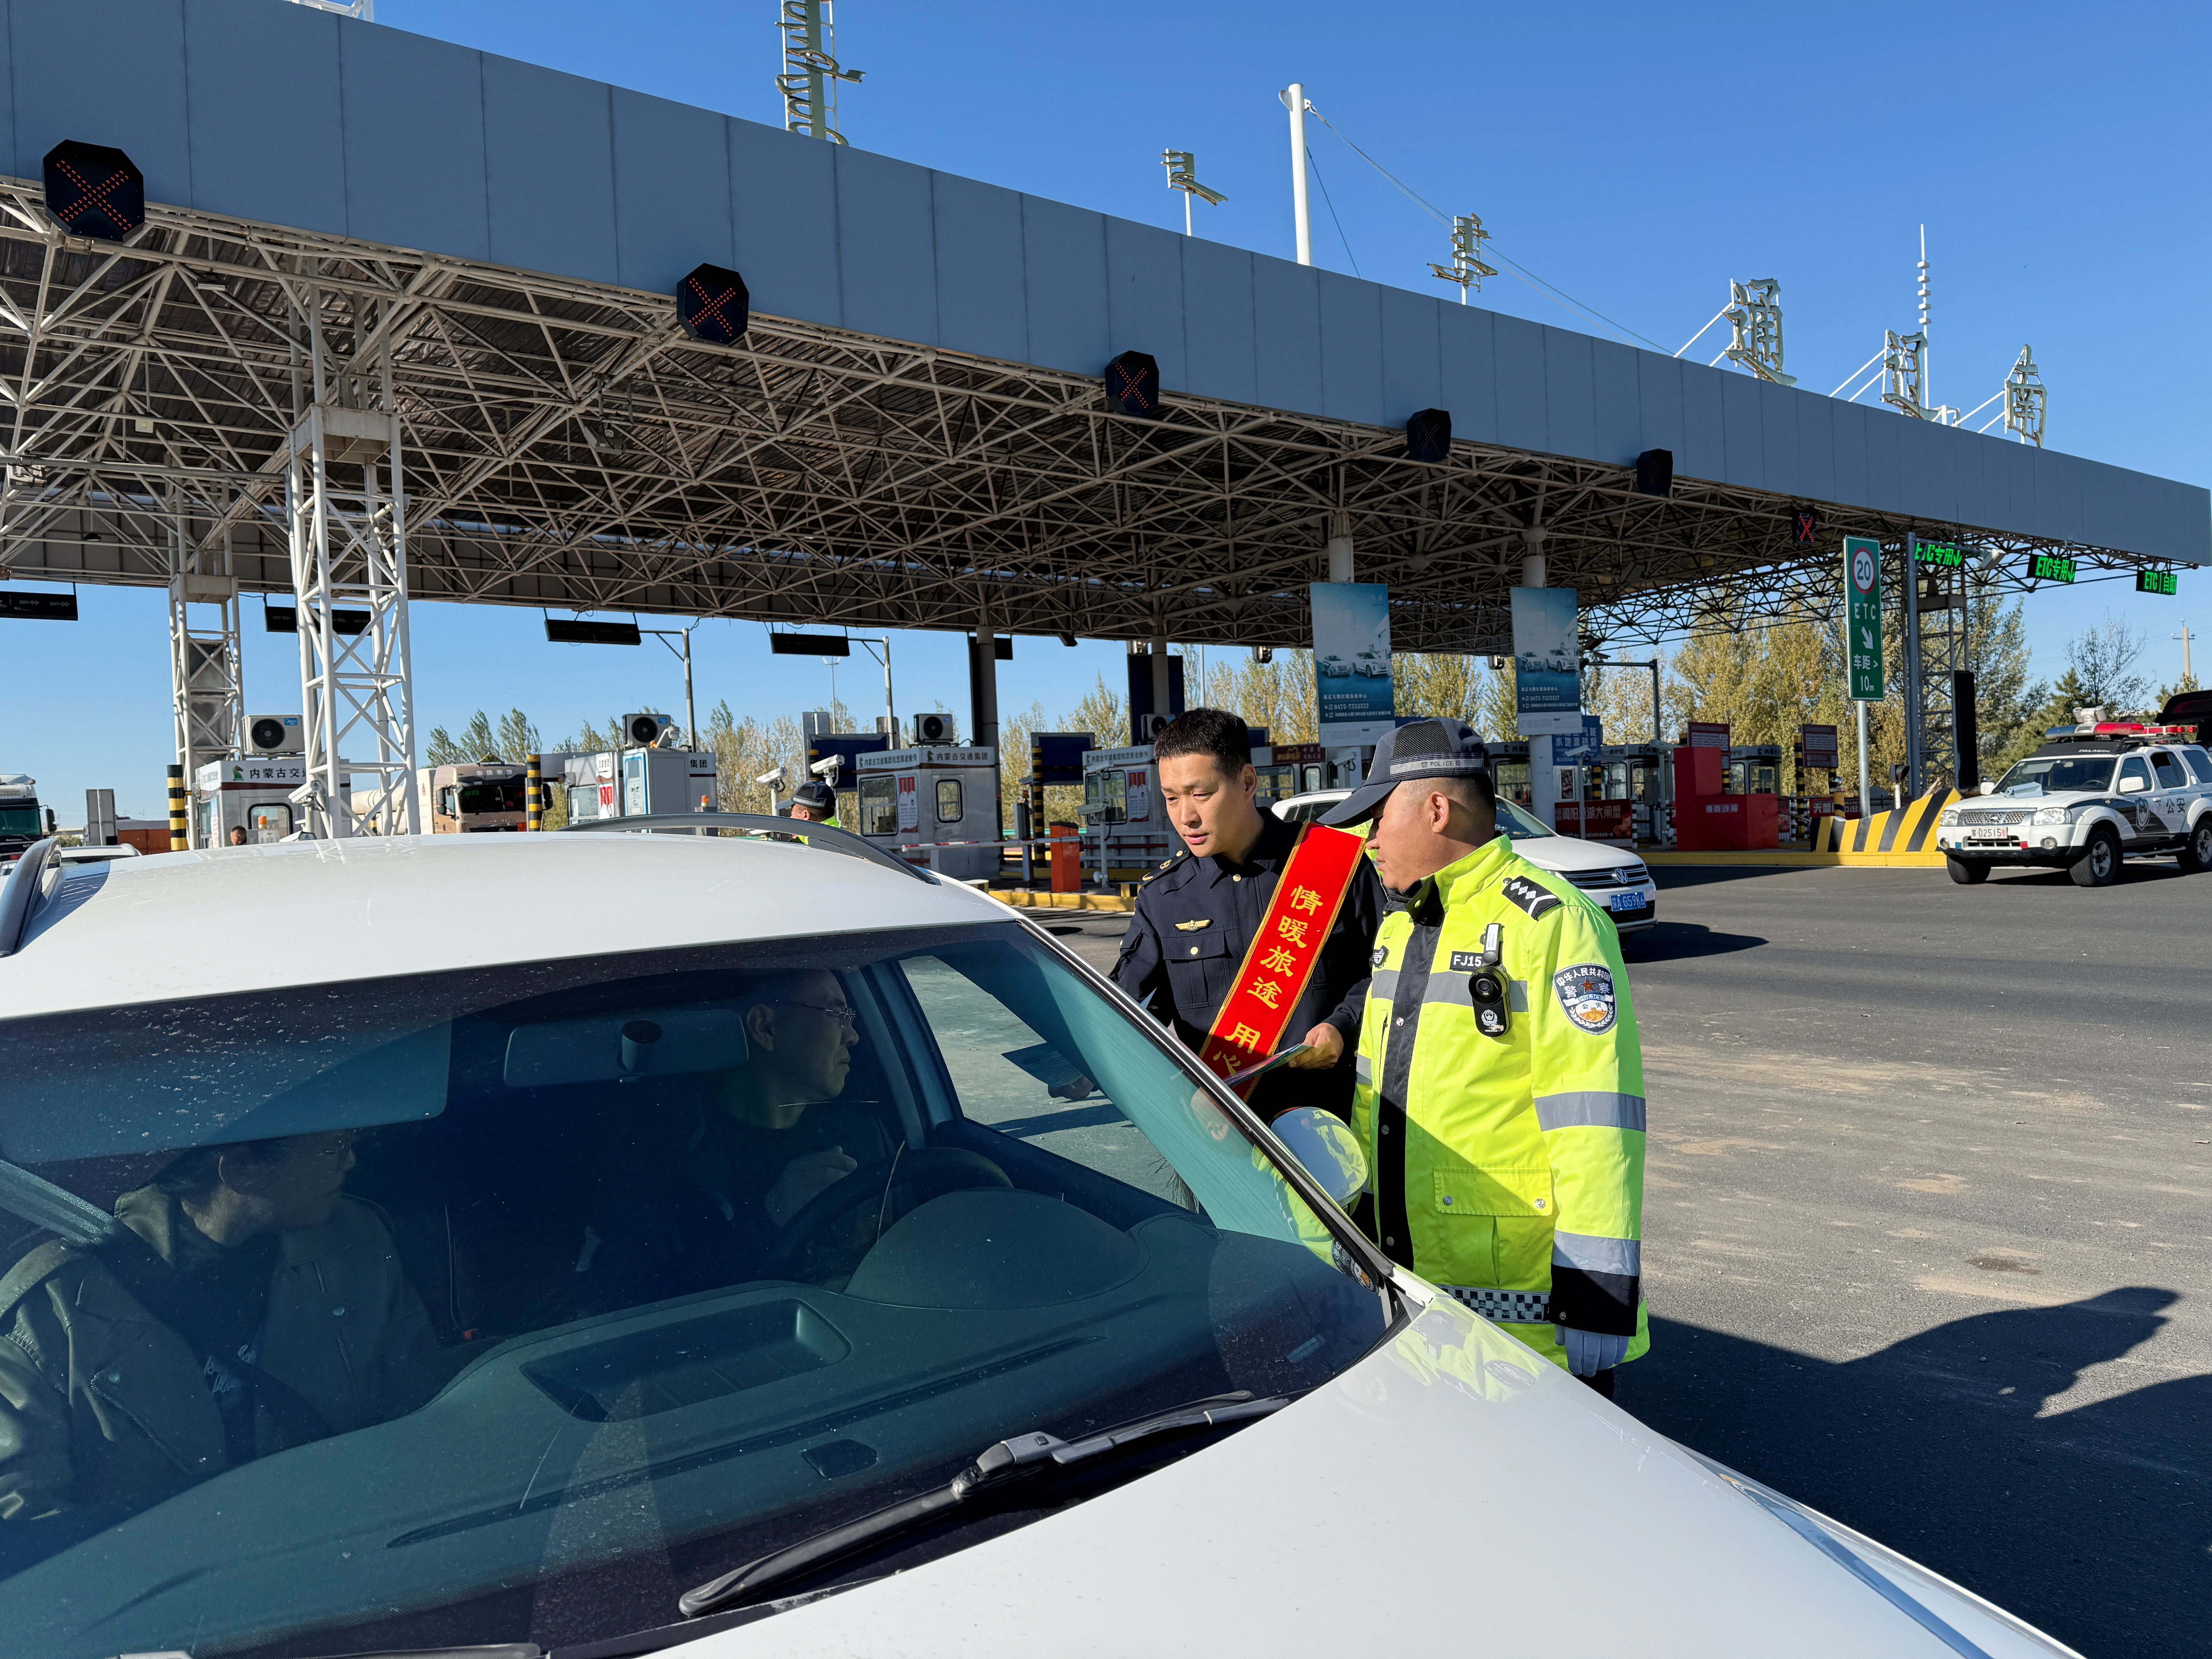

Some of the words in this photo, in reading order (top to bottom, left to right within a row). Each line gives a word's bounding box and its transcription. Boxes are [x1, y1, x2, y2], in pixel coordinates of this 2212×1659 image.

[1857, 560, 1871, 581] 20
[1854, 603, 1876, 620] ETC
[1853, 654, 1870, 670] 车距
[1860, 675, 1874, 692] 10m
[690, 759, 707, 768] 集团
[937, 752, 988, 761] 内蒙古交通集团
[1706, 804, 1739, 813] 消防沙箱
[2166, 796, 2185, 814] 公安
[1247, 885, 1323, 1010] 情暖旅途
[1556, 967, 1610, 987] 中华人民共和国
